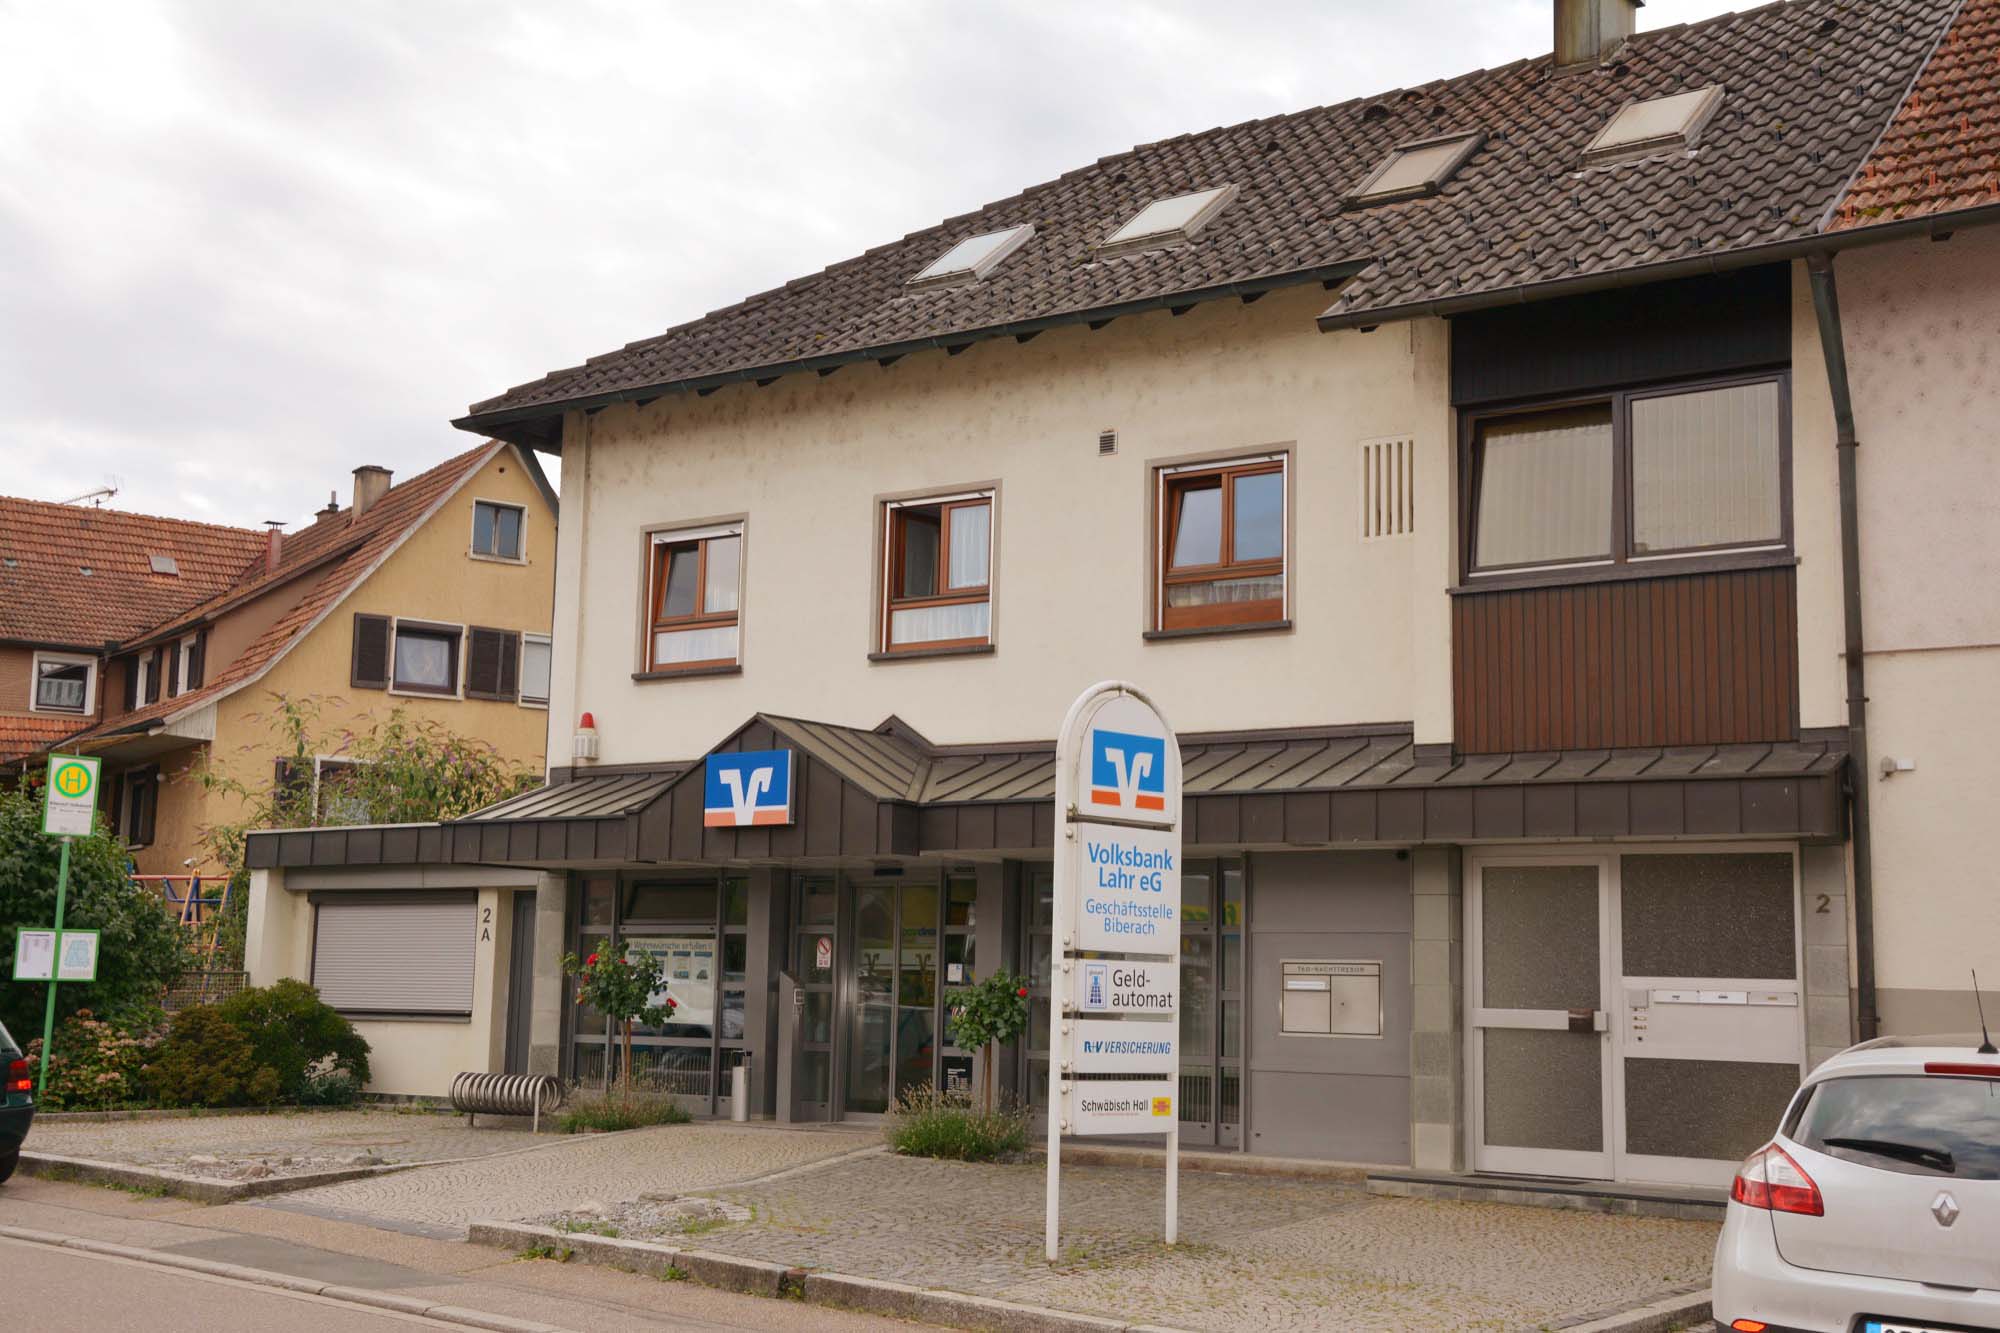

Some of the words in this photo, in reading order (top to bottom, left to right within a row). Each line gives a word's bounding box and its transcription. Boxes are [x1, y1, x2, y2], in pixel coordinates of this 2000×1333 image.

[65, 769, 81, 792] H
[1087, 842, 1173, 871] Volksbank
[1099, 866, 1135, 889] Lahr
[1140, 871, 1162, 892] eG
[1086, 898, 1173, 919] Geschäftsstelle
[1815, 893, 1831, 914] 2
[482, 907, 491, 924] 2
[481, 927, 490, 942] A
[1104, 917, 1155, 935] Biberach
[1113, 968, 1151, 988] Geld-
[1112, 990, 1173, 1008] automat
[1084, 1041, 1103, 1054] R+V
[1104, 1041, 1171, 1055] VERSICHERUNG
[1081, 1099, 1130, 1112] Schwäbisch
[1132, 1099, 1149, 1112] Hall
